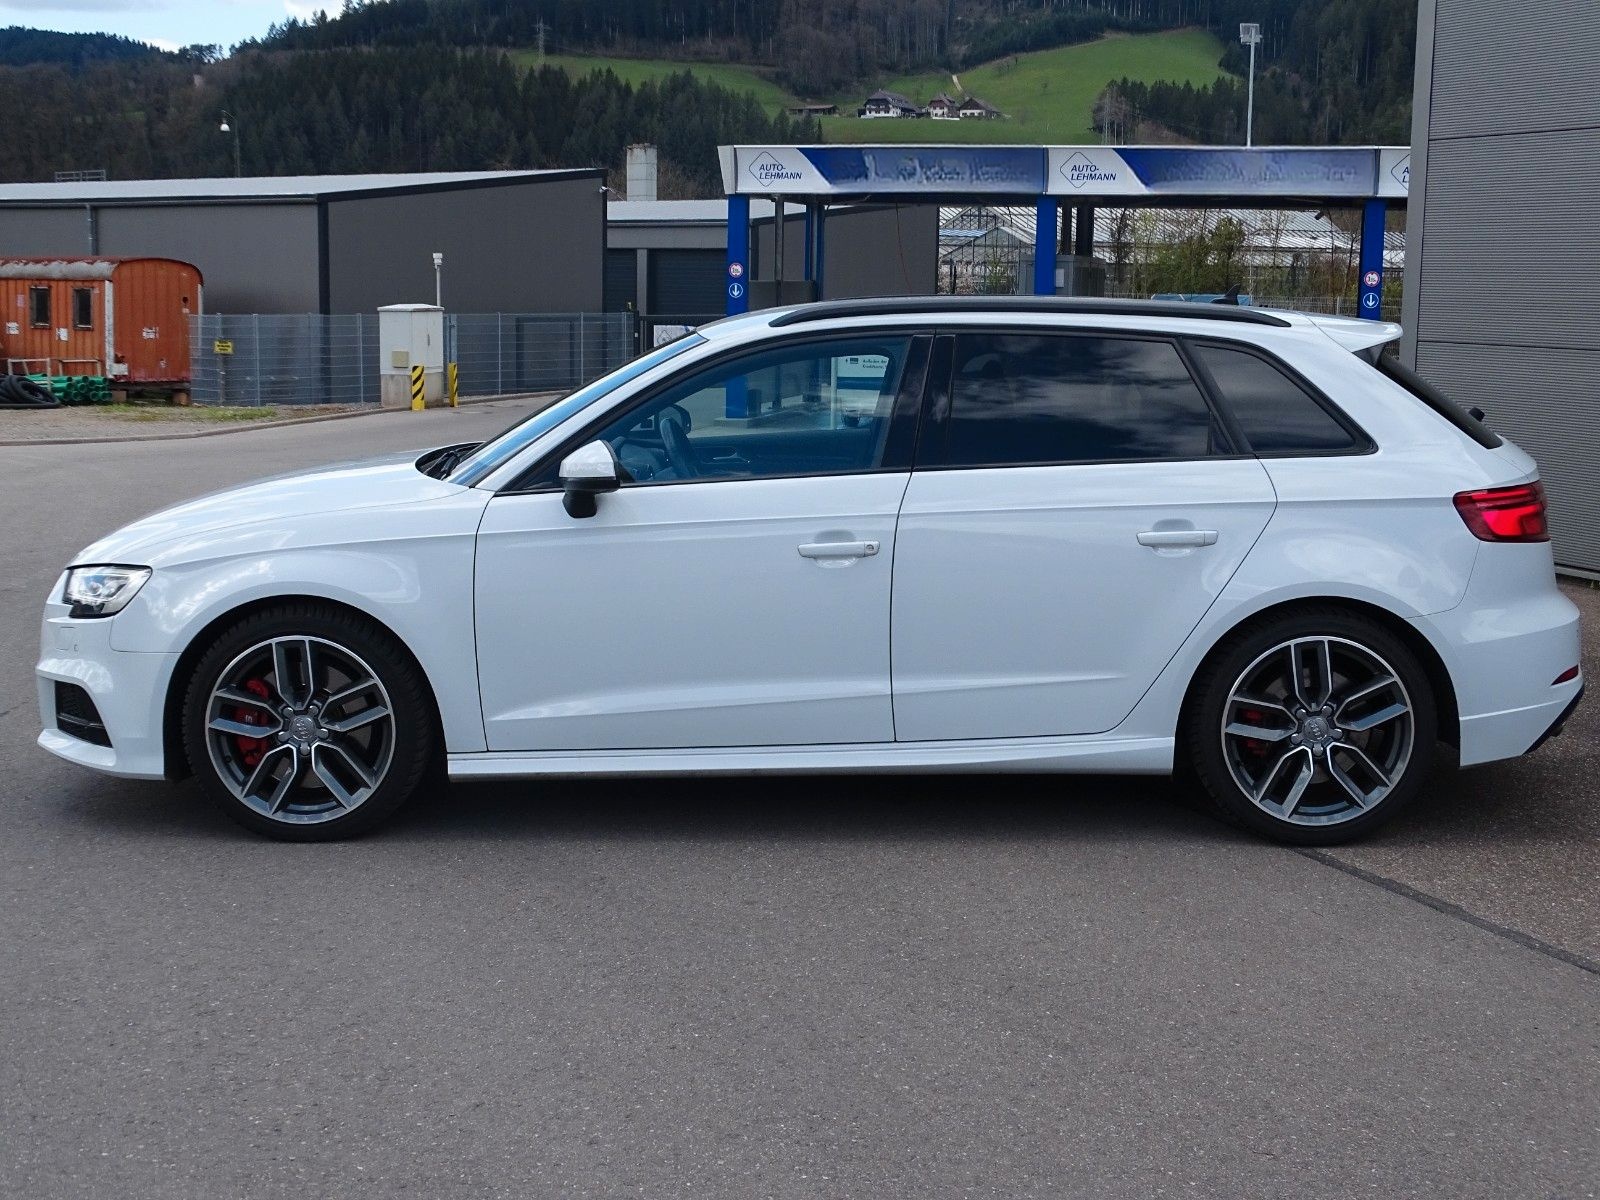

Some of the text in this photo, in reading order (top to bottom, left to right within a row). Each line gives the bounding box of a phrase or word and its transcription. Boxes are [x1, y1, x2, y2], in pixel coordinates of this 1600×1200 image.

[759, 163, 786, 172] AUTO-
[1070, 164, 1100, 173] AUTO-
[759, 171, 802, 180] LEHMANN
[1070, 173, 1117, 181] LEHMANN
